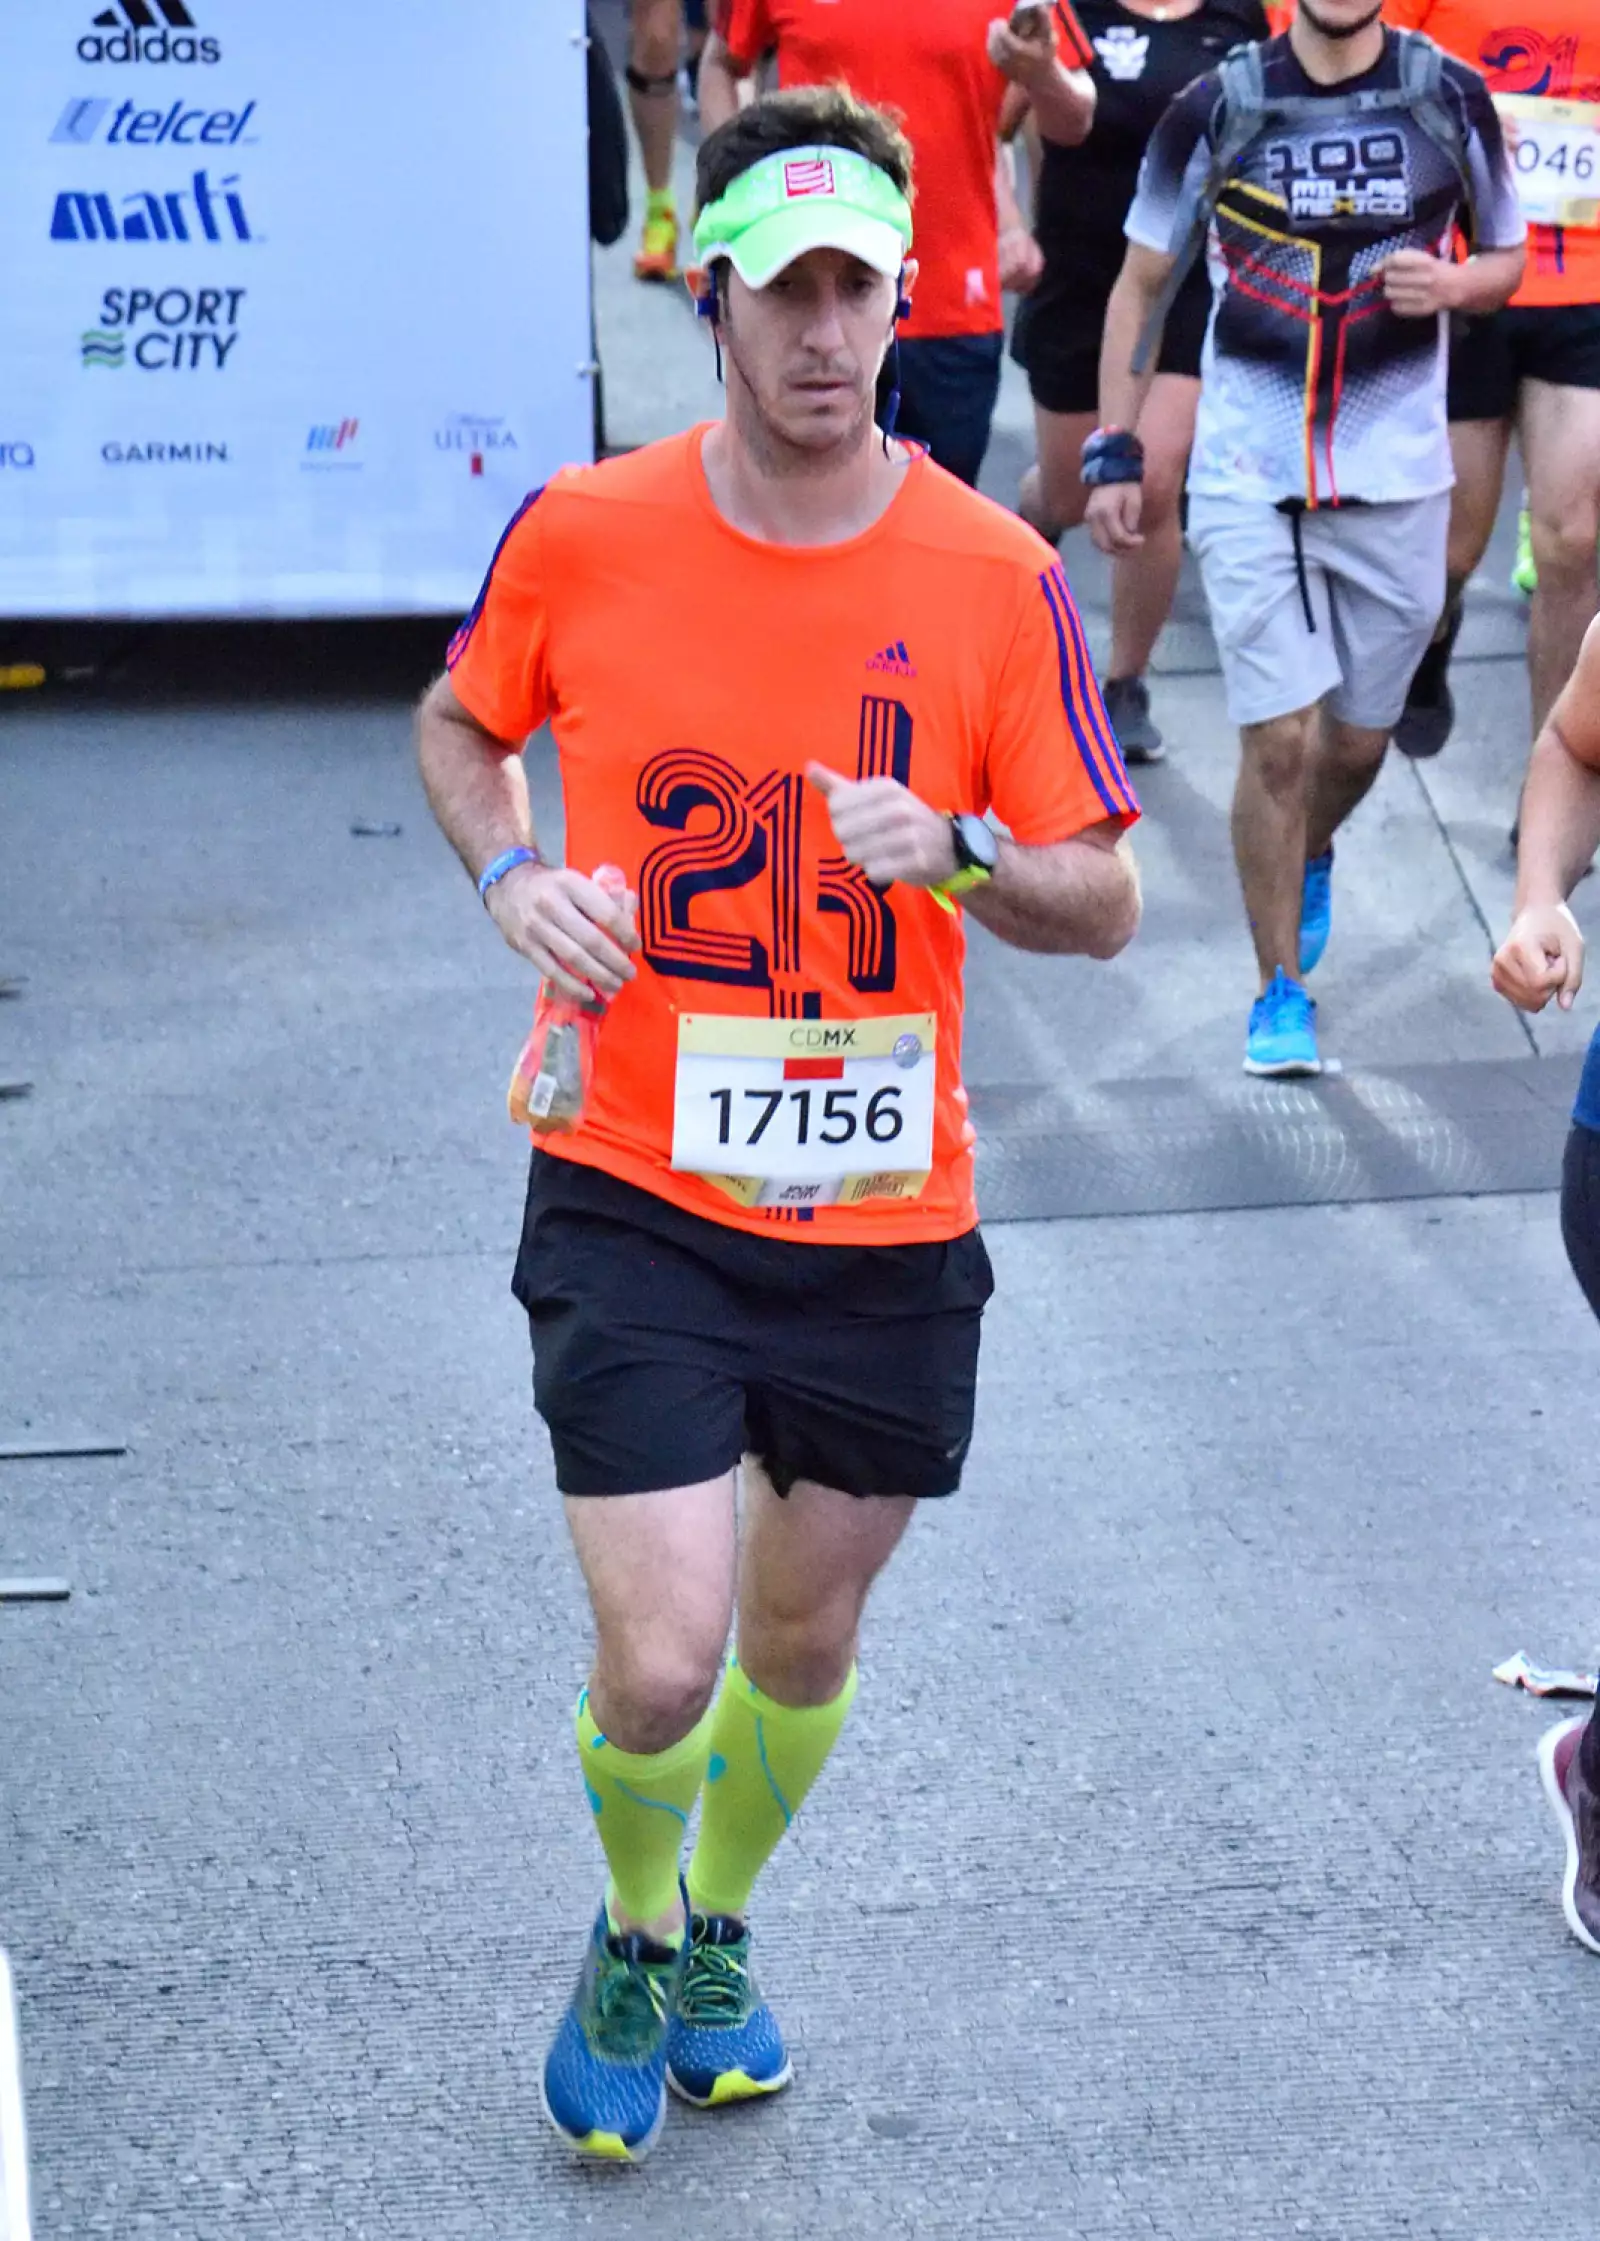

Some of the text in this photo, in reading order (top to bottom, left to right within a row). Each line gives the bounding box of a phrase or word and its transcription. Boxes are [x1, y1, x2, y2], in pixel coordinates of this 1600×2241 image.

[77, 29, 221, 63] adidas
[107, 99, 257, 144] telcel
[1270, 134, 1404, 180] 100
[100, 287, 247, 326] SPORT
[134, 331, 238, 370] CITY
[101, 441, 228, 463] GARMIN
[434, 430, 518, 450] ULTRA
[789, 1027, 857, 1047] CDMX
[709, 1085, 904, 1145] 17156
